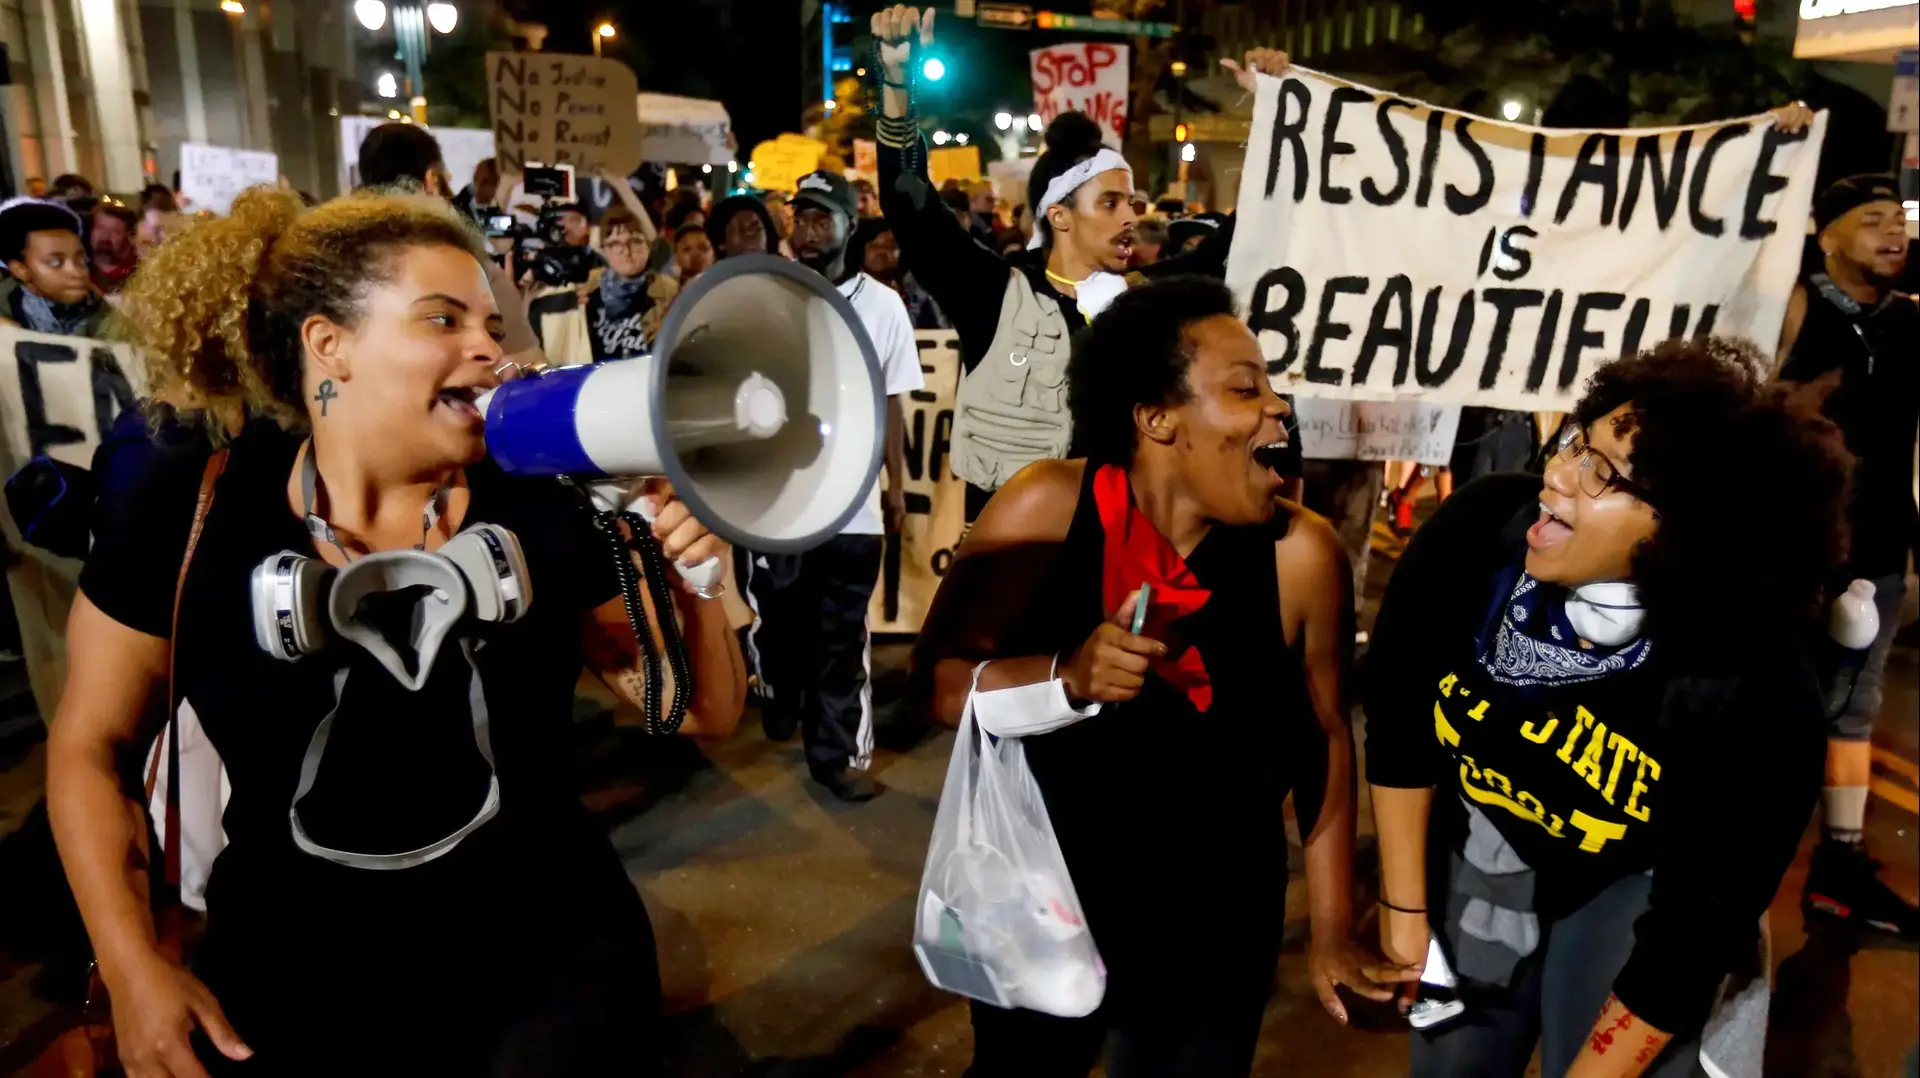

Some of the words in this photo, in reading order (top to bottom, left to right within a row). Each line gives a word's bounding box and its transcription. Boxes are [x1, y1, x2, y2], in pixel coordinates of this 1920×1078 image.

[495, 56, 540, 86] No
[1033, 44, 1116, 94] STOP
[496, 86, 542, 117] No
[496, 119, 540, 145] No
[498, 147, 539, 173] N
[1264, 78, 1812, 241] RESISTANCE
[1477, 225, 1540, 282] IS
